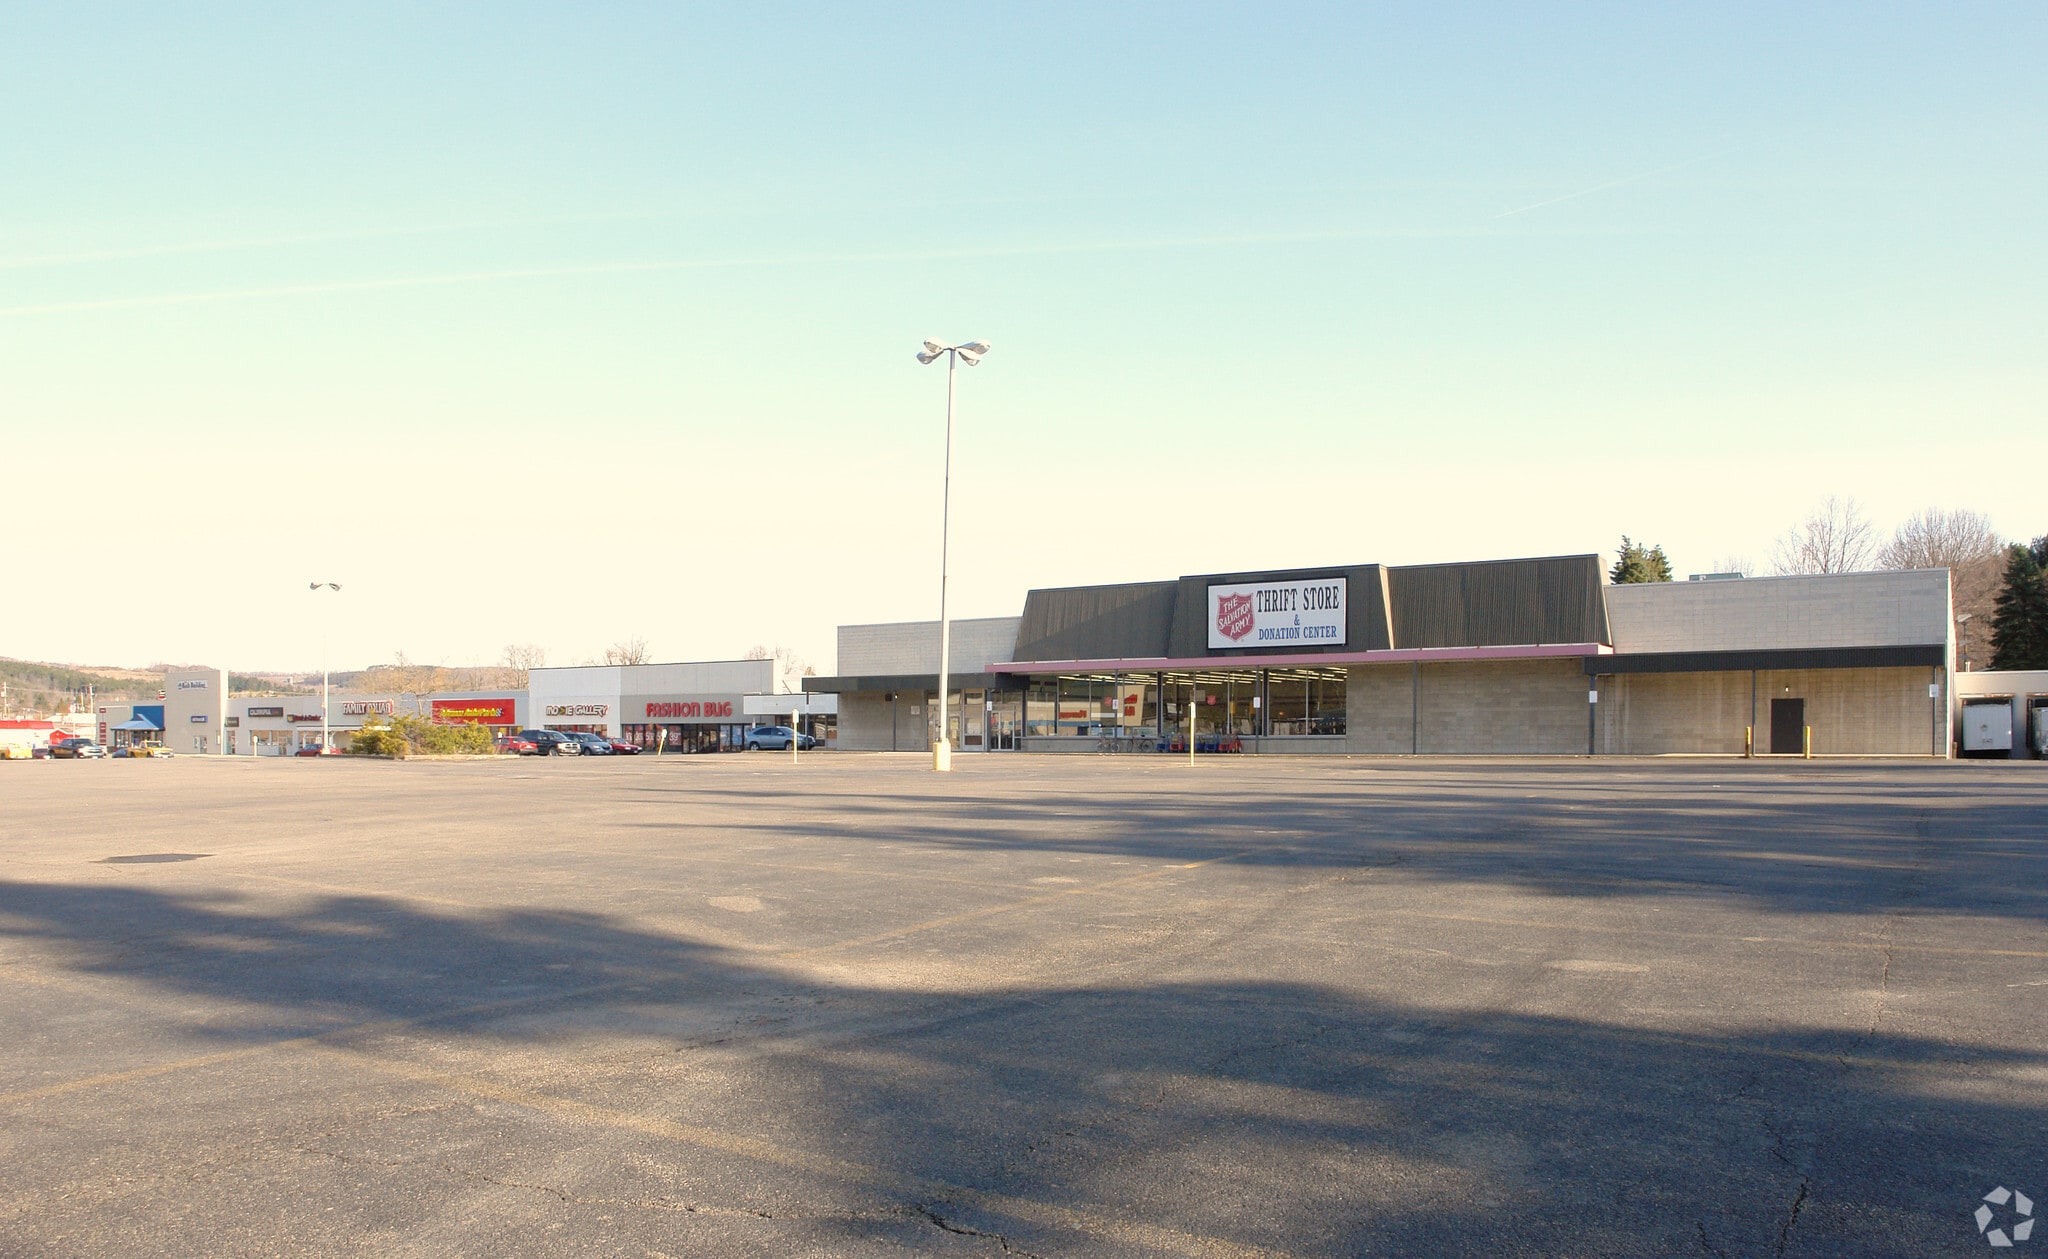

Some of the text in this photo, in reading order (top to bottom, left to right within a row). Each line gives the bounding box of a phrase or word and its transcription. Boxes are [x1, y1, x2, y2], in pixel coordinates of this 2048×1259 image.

[1223, 597, 1238, 614] THE
[1256, 586, 1339, 612] THRIFT STORE
[1218, 600, 1251, 630] SALVATION
[1293, 614, 1301, 626] &
[1229, 614, 1251, 636] ARMY
[1258, 625, 1337, 640] DONATION CENTER
[343, 703, 365, 714] FAMILY
[575, 704, 608, 717] GALLERY
[646, 701, 733, 718] FASHION BUG
